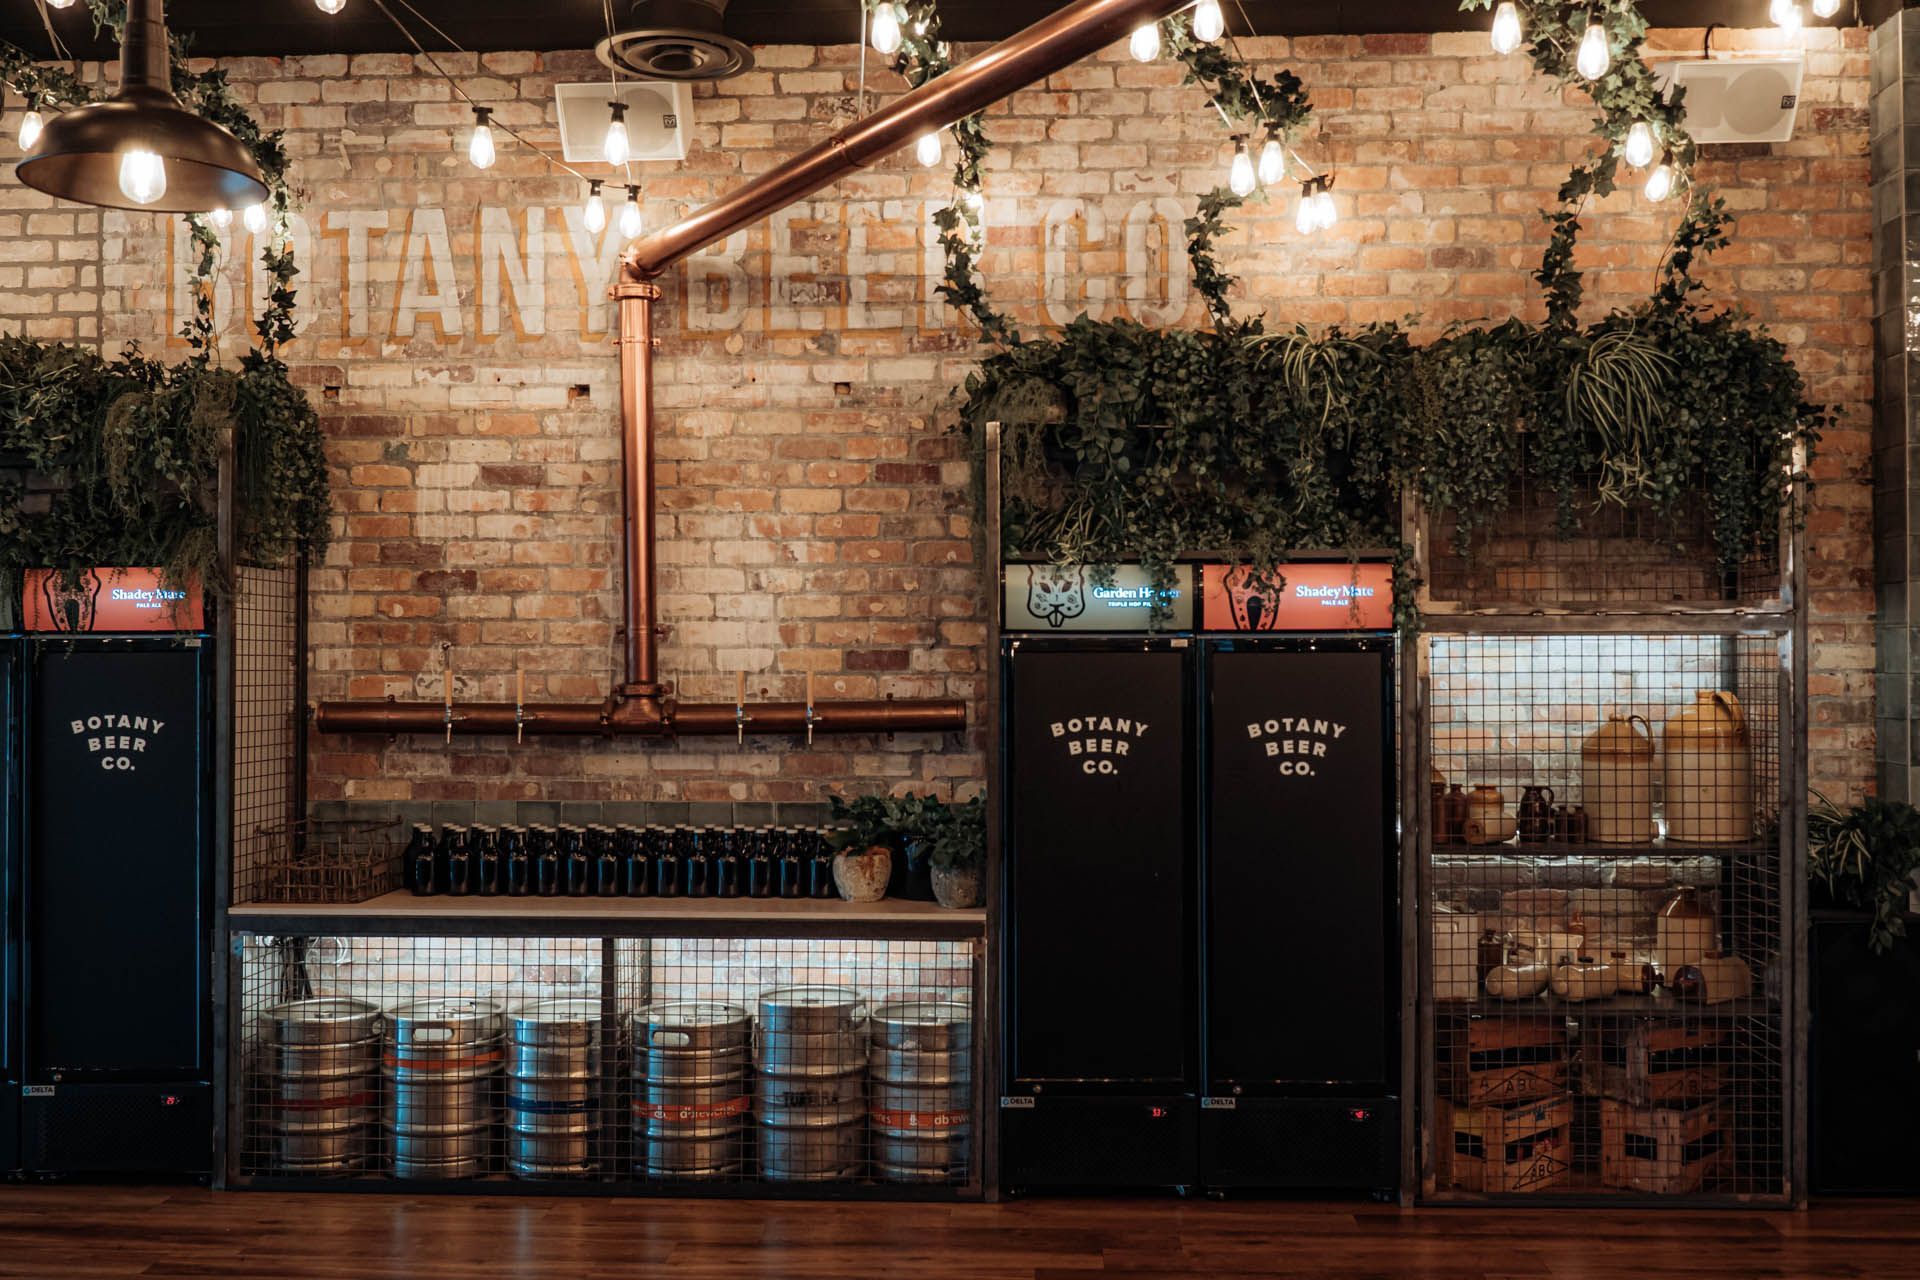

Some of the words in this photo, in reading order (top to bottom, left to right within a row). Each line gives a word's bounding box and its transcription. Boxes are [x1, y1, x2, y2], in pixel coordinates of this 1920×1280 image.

[166, 206, 618, 348] BOTANY
[112, 589, 154, 602] Shadey
[1094, 587, 1137, 599] Garden
[1296, 585, 1340, 599] Shadey
[1342, 585, 1374, 597] Mate
[71, 714, 165, 734] BOTANY
[1050, 716, 1149, 737] BOTANY
[1247, 717, 1346, 738] BOTANY
[88, 735, 146, 752] BEER
[1068, 738, 1130, 756] BEER
[1265, 739, 1327, 757] BEER
[101, 756, 136, 771] CO.
[1082, 759, 1118, 775] CO.
[1279, 761, 1316, 776] CO.
[31, 1086, 54, 1094] DELTA
[1010, 1097, 1034, 1106] DELTA
[1210, 1098, 1235, 1106] DELTA
